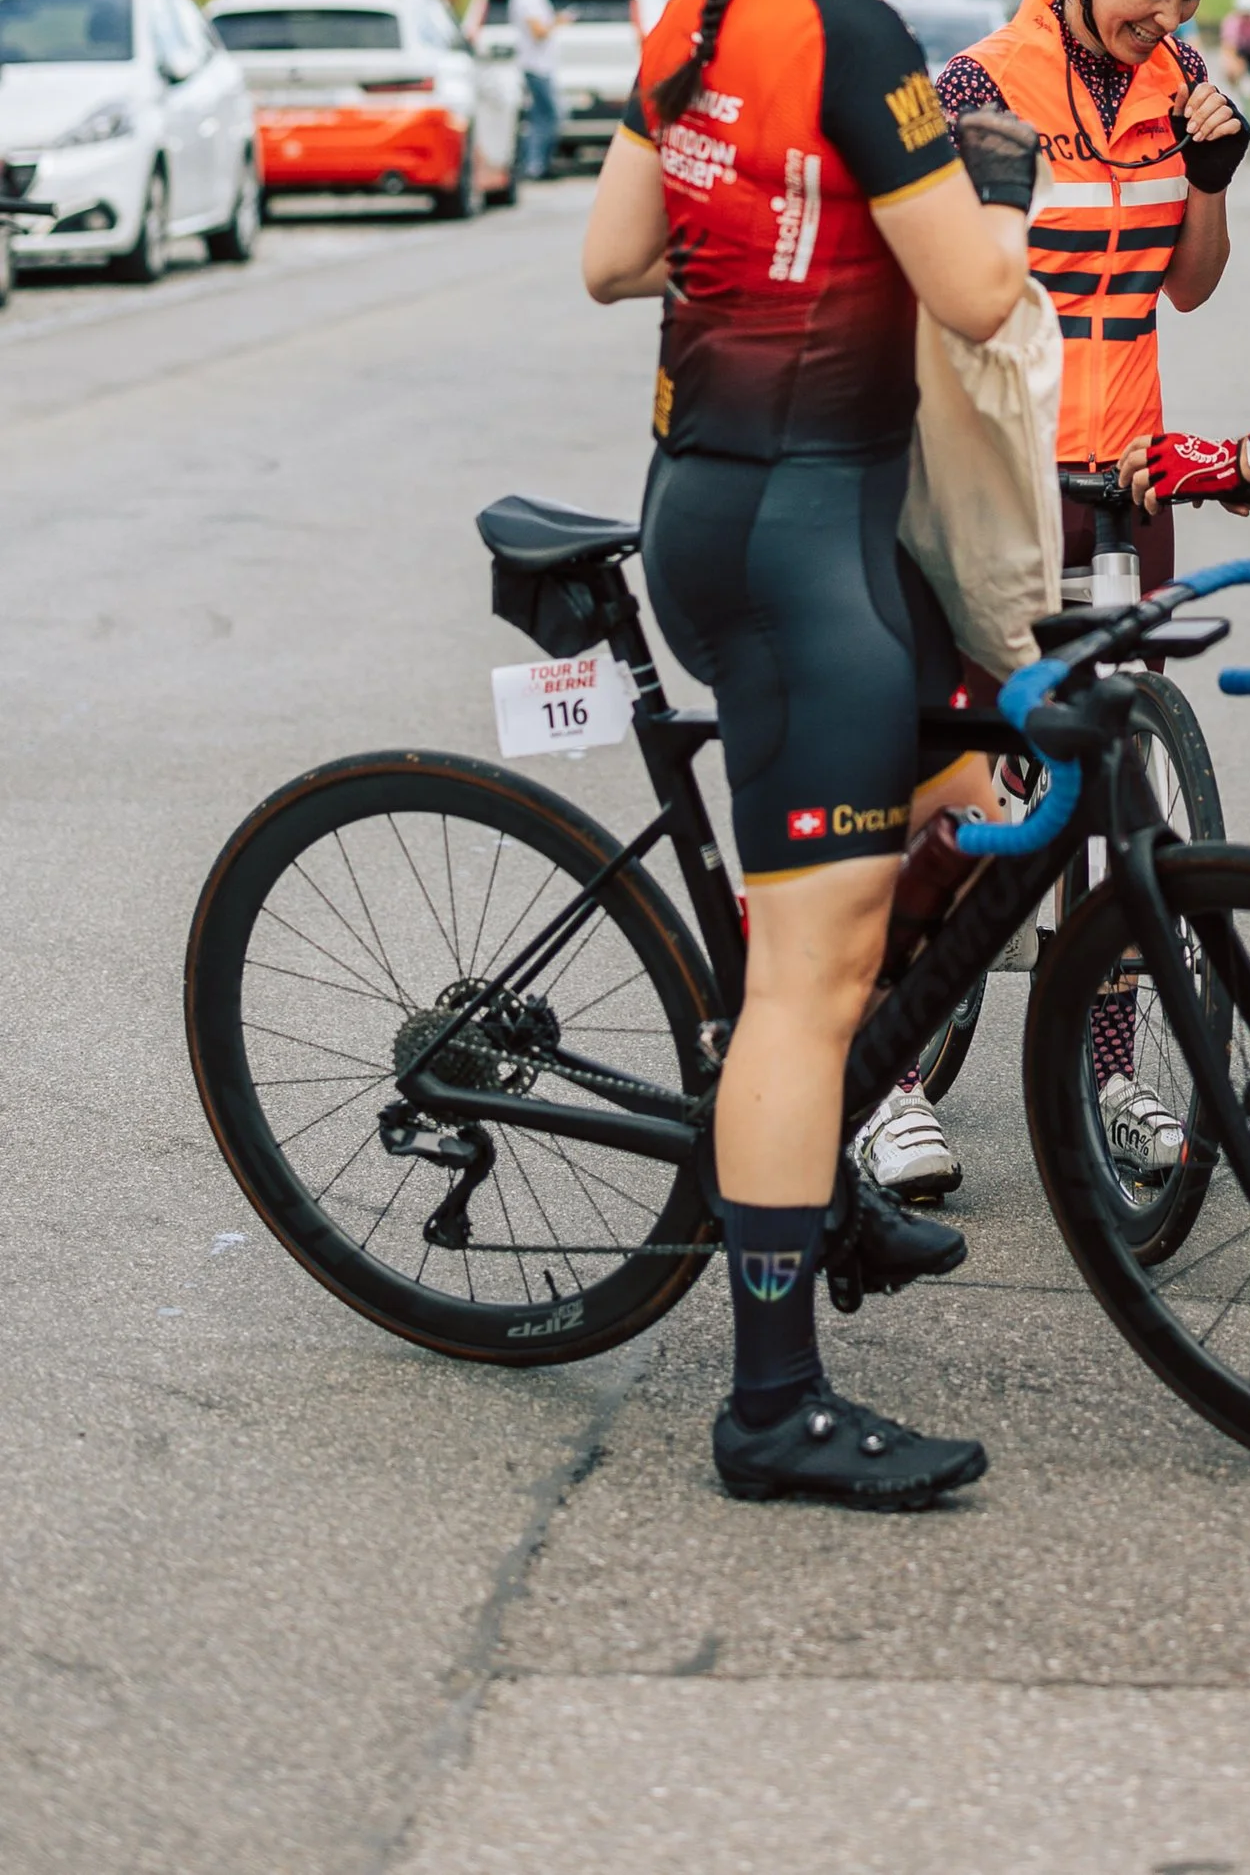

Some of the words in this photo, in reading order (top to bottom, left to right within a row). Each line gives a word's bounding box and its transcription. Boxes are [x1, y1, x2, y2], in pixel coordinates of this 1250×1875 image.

[530, 663, 573, 681] TOUR
[577, 658, 598, 674] DE
[544, 676, 596, 694] BERNE
[541, 698, 588, 729] 116
